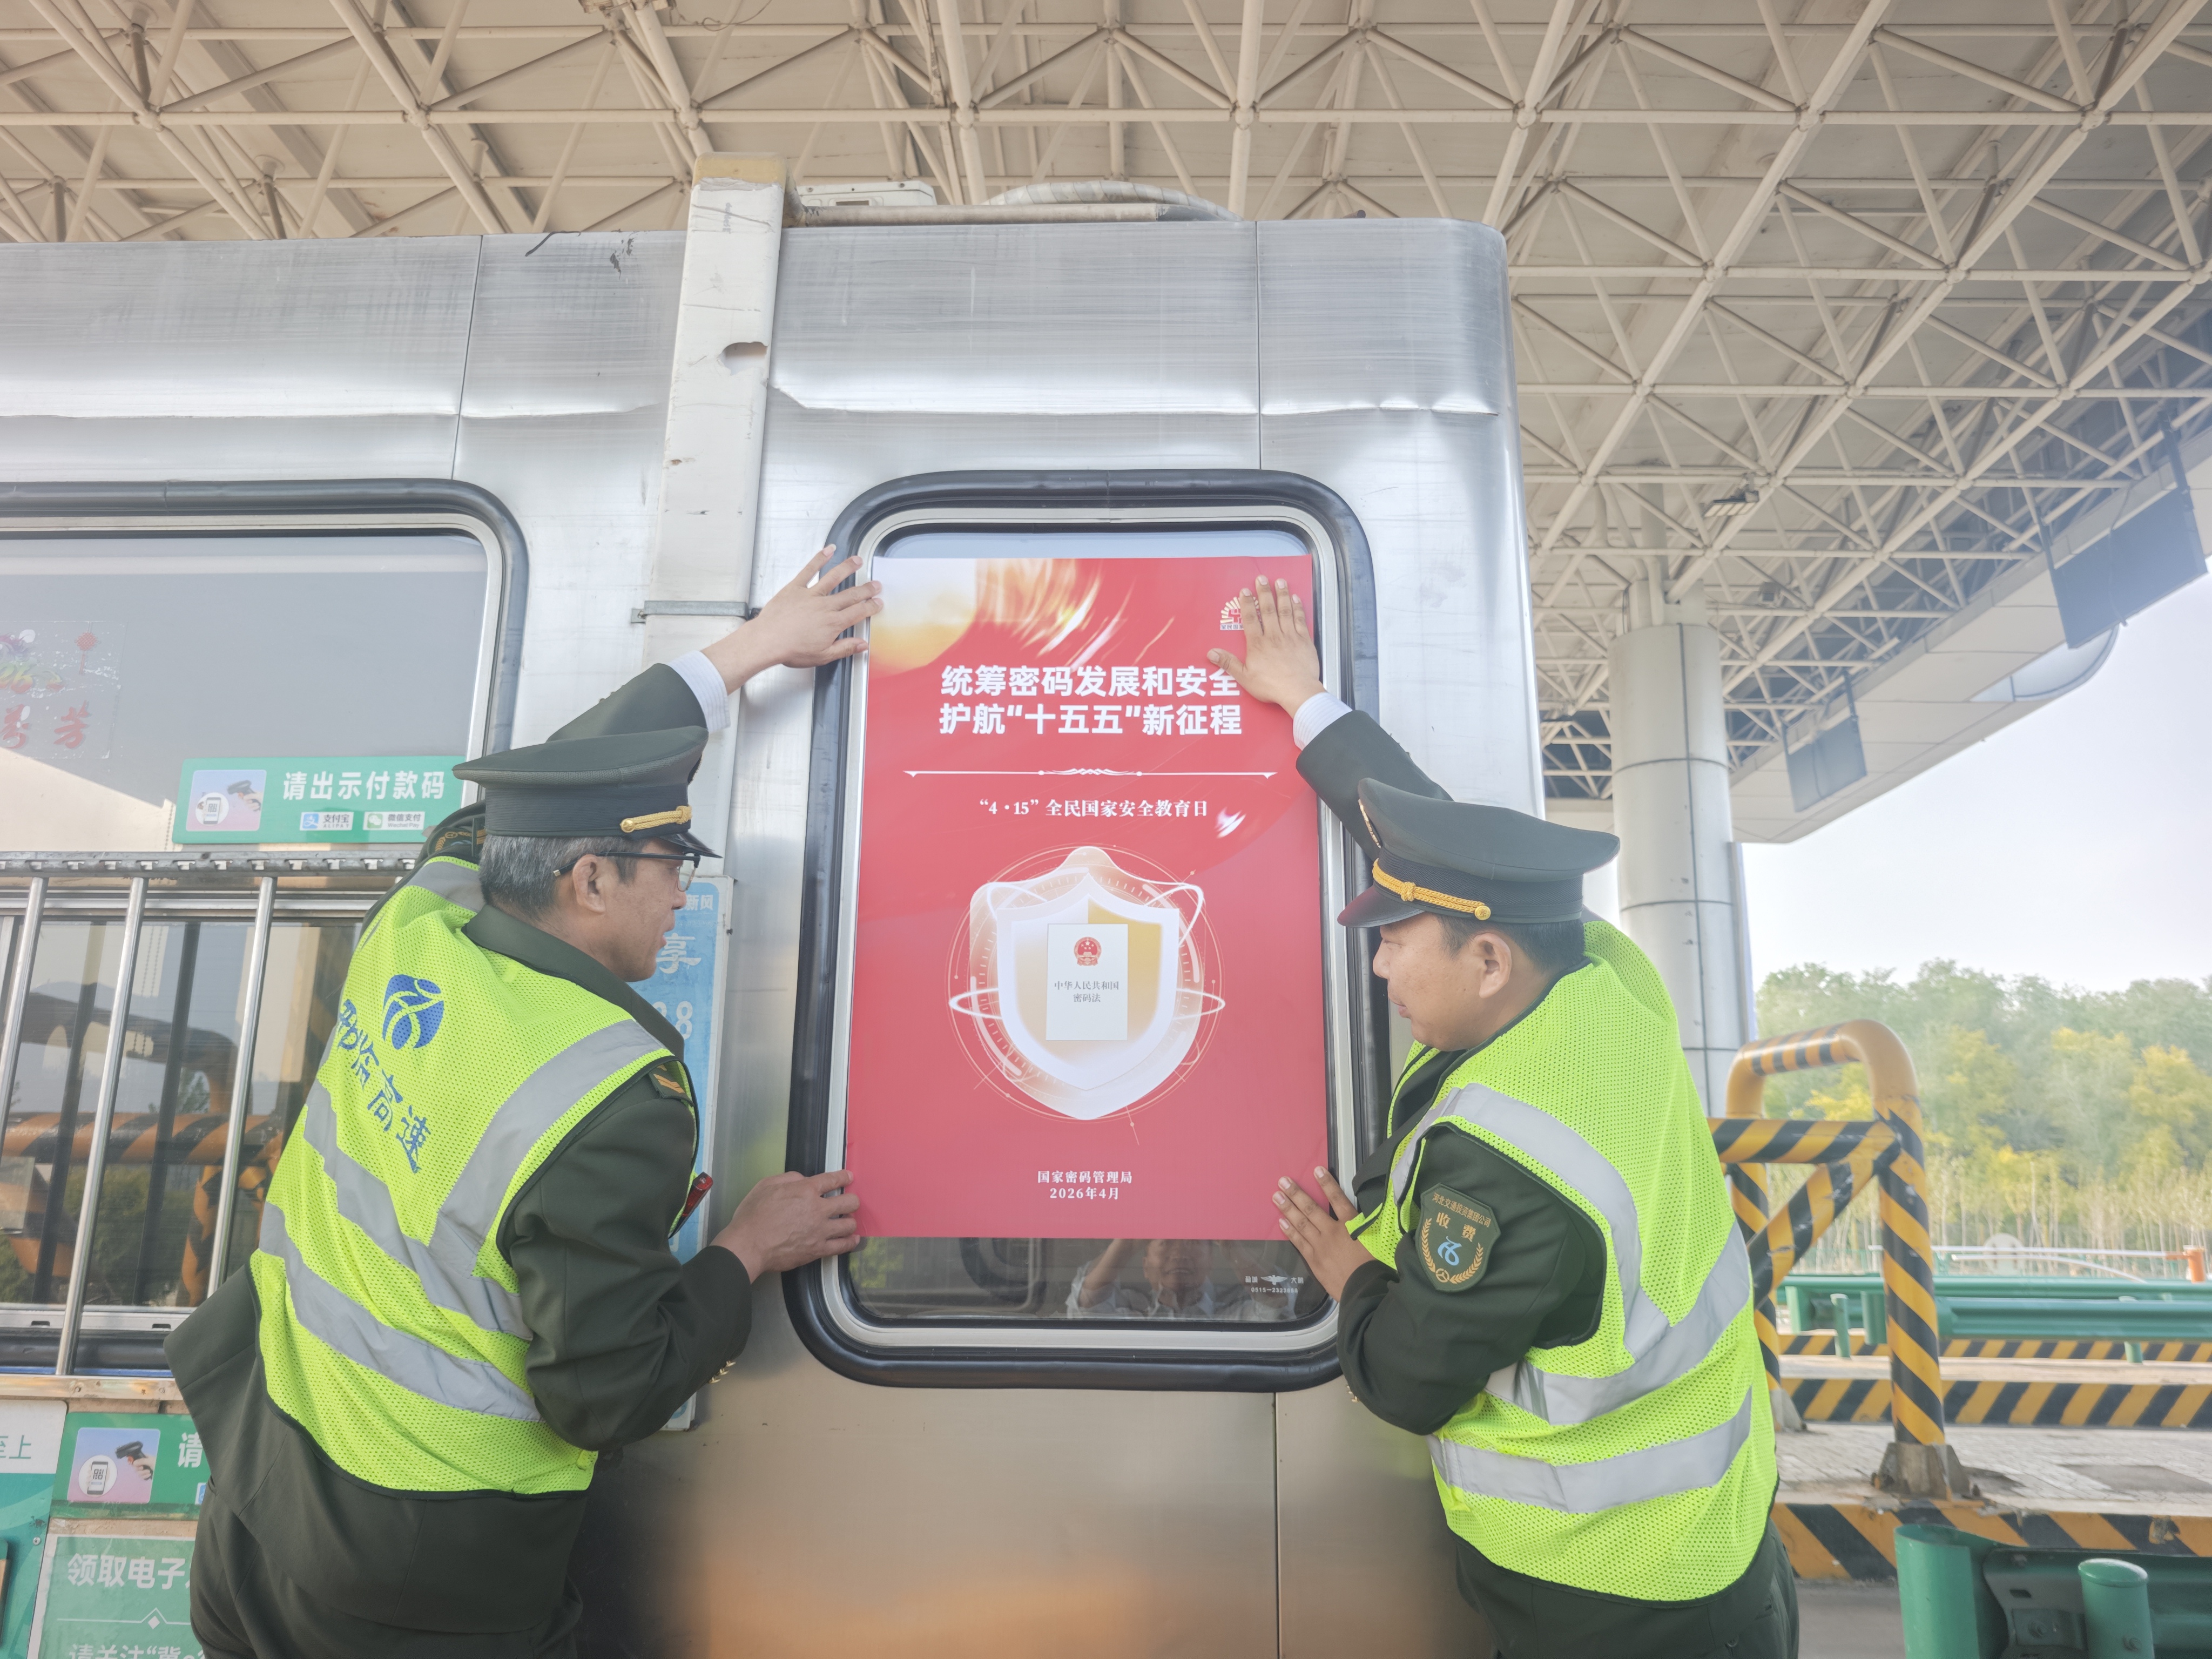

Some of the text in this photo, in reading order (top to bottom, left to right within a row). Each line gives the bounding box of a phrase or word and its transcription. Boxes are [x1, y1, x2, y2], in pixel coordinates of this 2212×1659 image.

[941, 665, 1240, 697] 统筹密码发展和安全
[939, 703, 1243, 736] 护航“十五五”新征程
[283, 771, 445, 800] 请出示付款码
[1046, 800, 1208, 817] 全民国家安全教育日
[323, 814, 350, 824] 支付宝
[387, 814, 421, 822] 微信支付
[1054, 980, 1120, 991] 中华人民共和国
[1073, 993, 1101, 1003] 密码法
[1037, 1170, 1132, 1184] 国家密码管理局
[1049, 1186, 1120, 1199] 2026年4月
[1432, 1192, 1492, 1228] 河北交通投资集团公司
[1436, 1212, 1476, 1242] 收费
[68, 1553, 190, 1590] 领取电子
